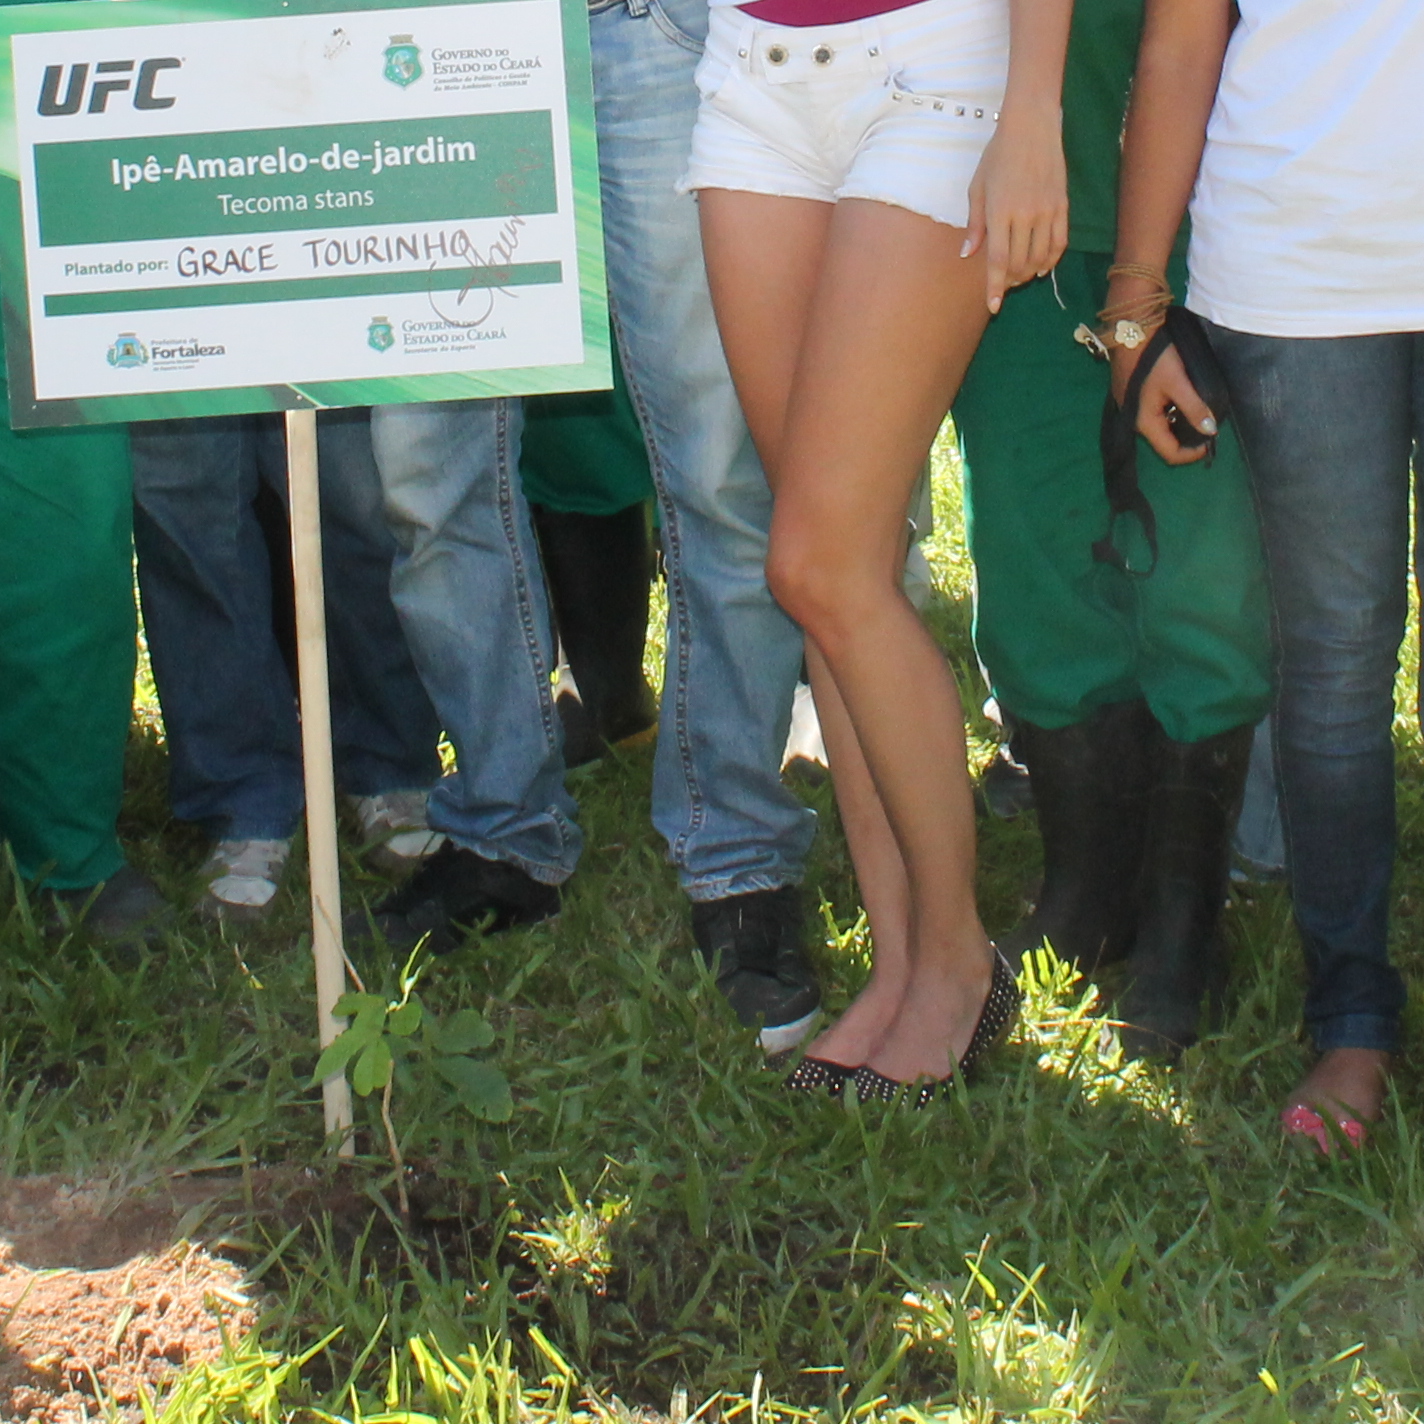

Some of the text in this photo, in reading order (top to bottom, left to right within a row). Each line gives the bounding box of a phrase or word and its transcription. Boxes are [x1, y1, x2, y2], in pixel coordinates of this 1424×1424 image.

[37, 57, 182, 116] UFC
[111, 136, 476, 191] Ipê-Amarelo-de-jardim
[217, 188, 374, 216] Tecoma stans
[64, 260, 169, 278] Plantado por:
[176, 228, 470, 278] GRACE TOURINHO
[152, 344, 225, 359] Fortaleza
